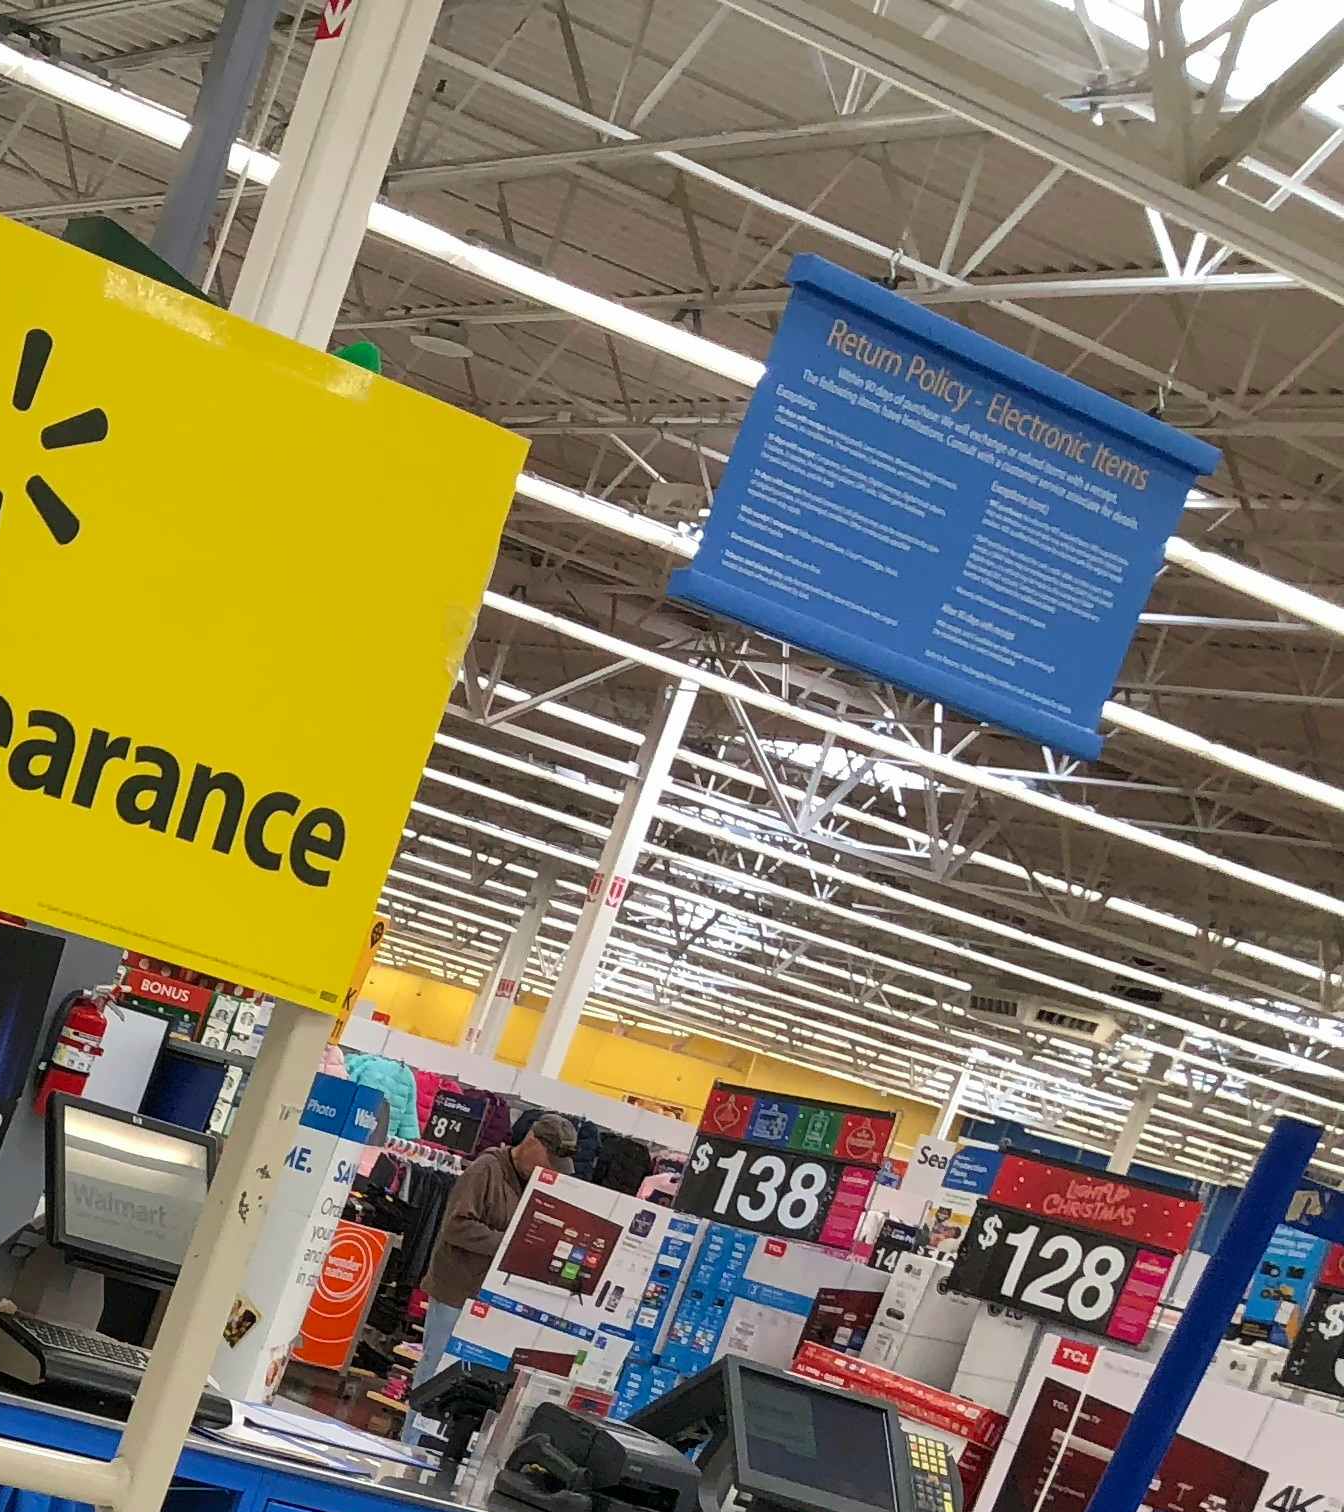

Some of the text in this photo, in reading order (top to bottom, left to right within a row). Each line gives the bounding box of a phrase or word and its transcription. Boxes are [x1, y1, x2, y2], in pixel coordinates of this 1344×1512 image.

[827, 319, 902, 376] Return
[905, 356, 973, 413] Policy
[986, 393, 1091, 464] Electronic
[1092, 441, 1150, 491] Items
[140, 978, 191, 1003] BONUS
[306, 1099, 337, 1119] Photo
[917, 1145, 949, 1170] Sea
[691, 1141, 828, 1231] $138
[1065, 1179, 1106, 1201] LIGHT
[71, 1181, 168, 1223] Walmart
[1042, 1193, 1137, 1227] CHRISTMAS
[977, 1213, 1126, 1321] $128
[1061, 1346, 1090, 1366] TCL
